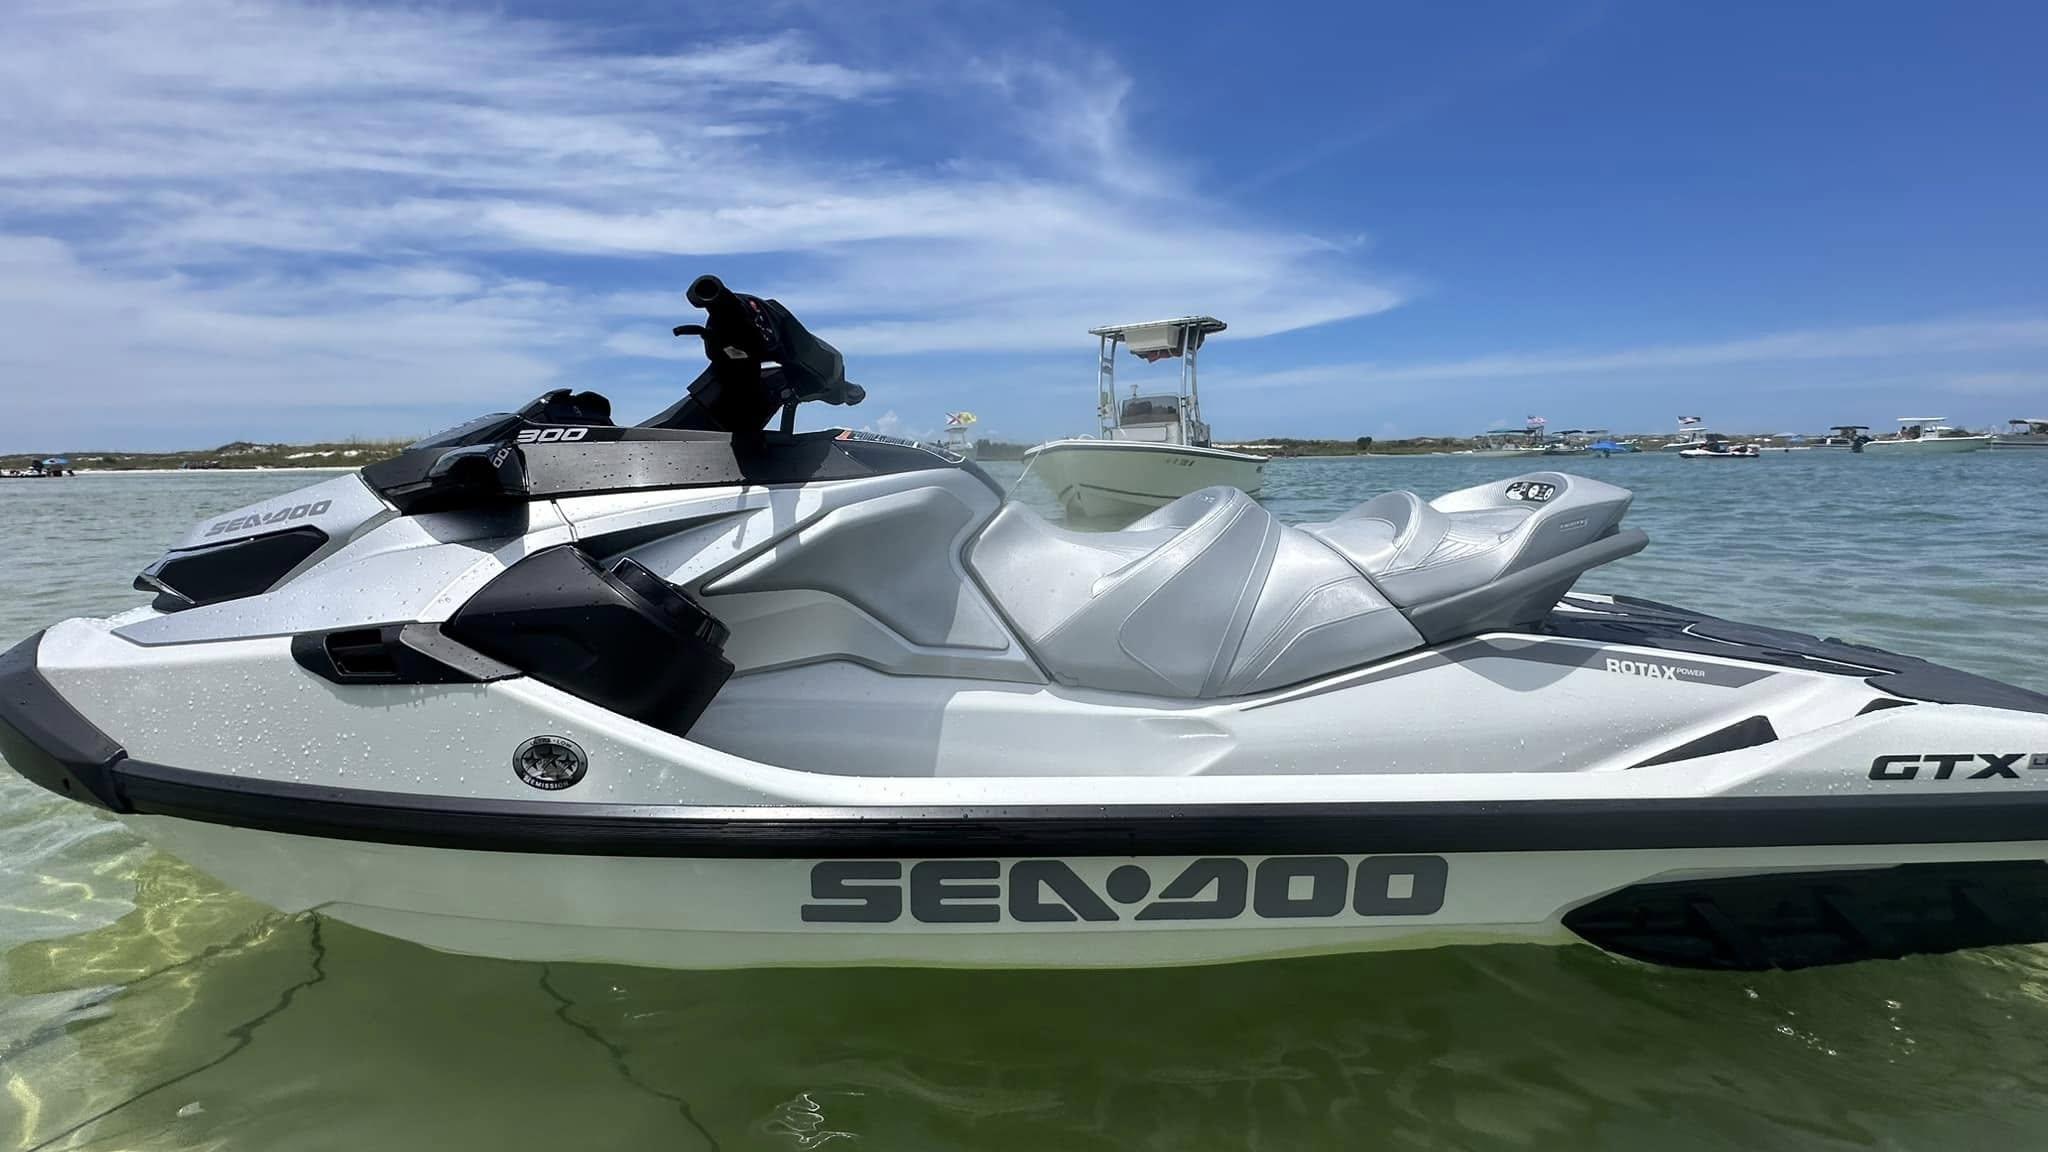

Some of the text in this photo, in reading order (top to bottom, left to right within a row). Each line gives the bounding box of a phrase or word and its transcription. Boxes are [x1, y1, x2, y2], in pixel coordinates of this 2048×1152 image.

[517, 428, 588, 442] 300
[1606, 658, 1705, 681] ROTAX POWER
[1868, 753, 2026, 780] GTX
